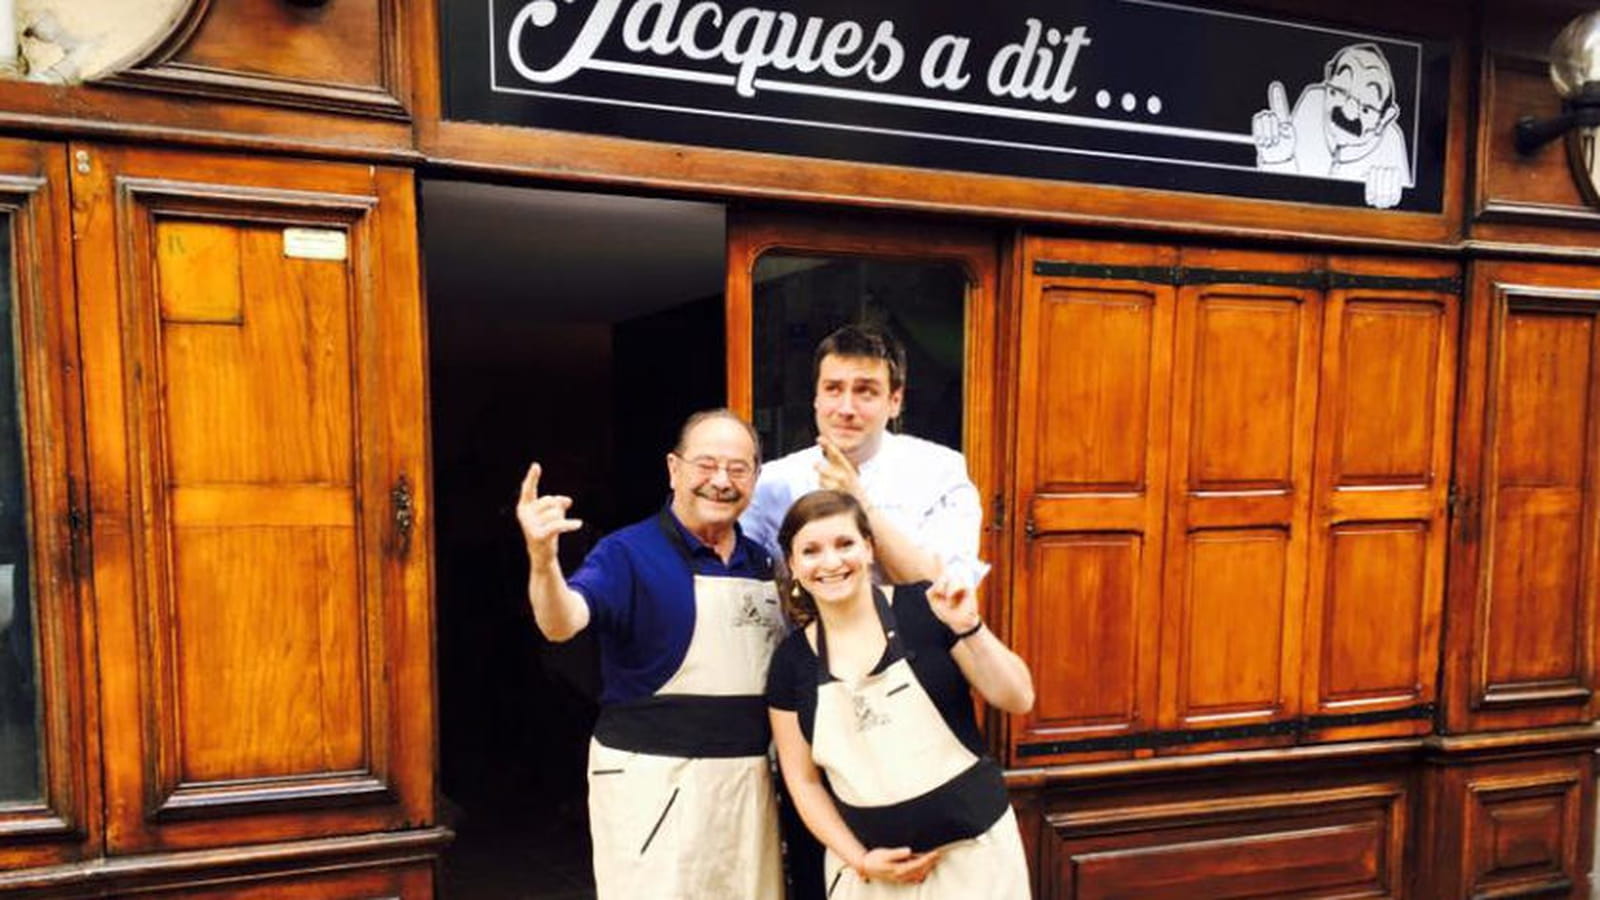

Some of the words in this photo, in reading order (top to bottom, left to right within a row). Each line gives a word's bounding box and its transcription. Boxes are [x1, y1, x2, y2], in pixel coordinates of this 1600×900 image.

[508, 0, 904, 97] Jacques
[920, 34, 971, 91] a
[987, 18, 1092, 103] dit
